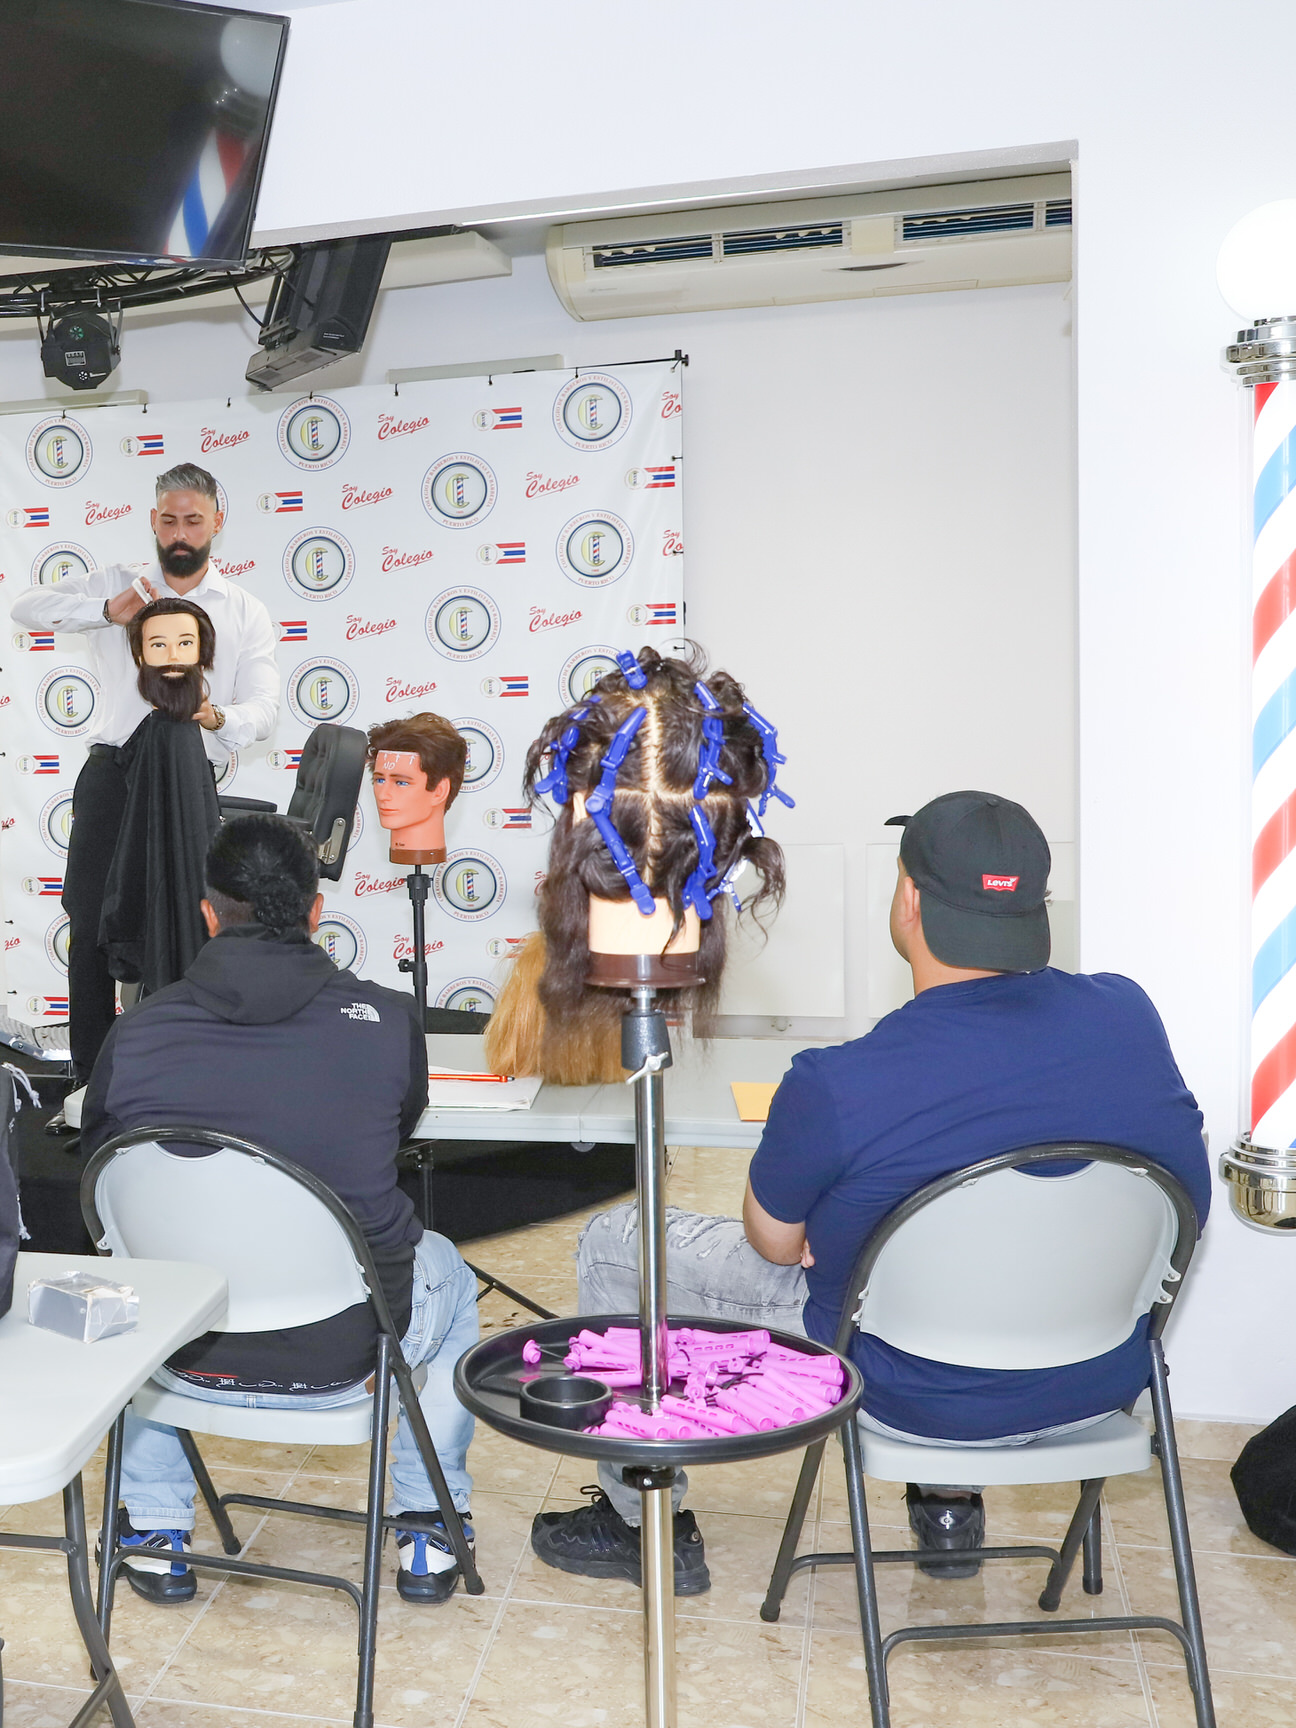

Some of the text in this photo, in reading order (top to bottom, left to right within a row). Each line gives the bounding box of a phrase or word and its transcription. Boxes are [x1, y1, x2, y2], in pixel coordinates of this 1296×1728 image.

[378, 414, 394, 423] Soy
[201, 427, 216, 436] Soy
[378, 416, 430, 440] Colegio
[201, 430, 250, 453] Colegio
[526, 472, 542, 480] Soy
[342, 484, 358, 493] Soy
[526, 474, 580, 498] Colegio
[85, 501, 100, 510] Soy
[342, 487, 393, 510] Colegio
[85, 504, 131, 525] Colegio
[382, 546, 398, 555] Soy
[216, 560, 255, 575] olegio
[382, 550, 433, 572] Colegio
[529, 606, 546, 615] Soy
[346, 615, 362, 623] Soy
[529, 610, 582, 632] Colegio
[346, 619, 396, 640] Colegio
[386, 678, 402, 686] Soy
[386, 682, 437, 702] Colegio
[355, 878, 404, 896] Colegio
